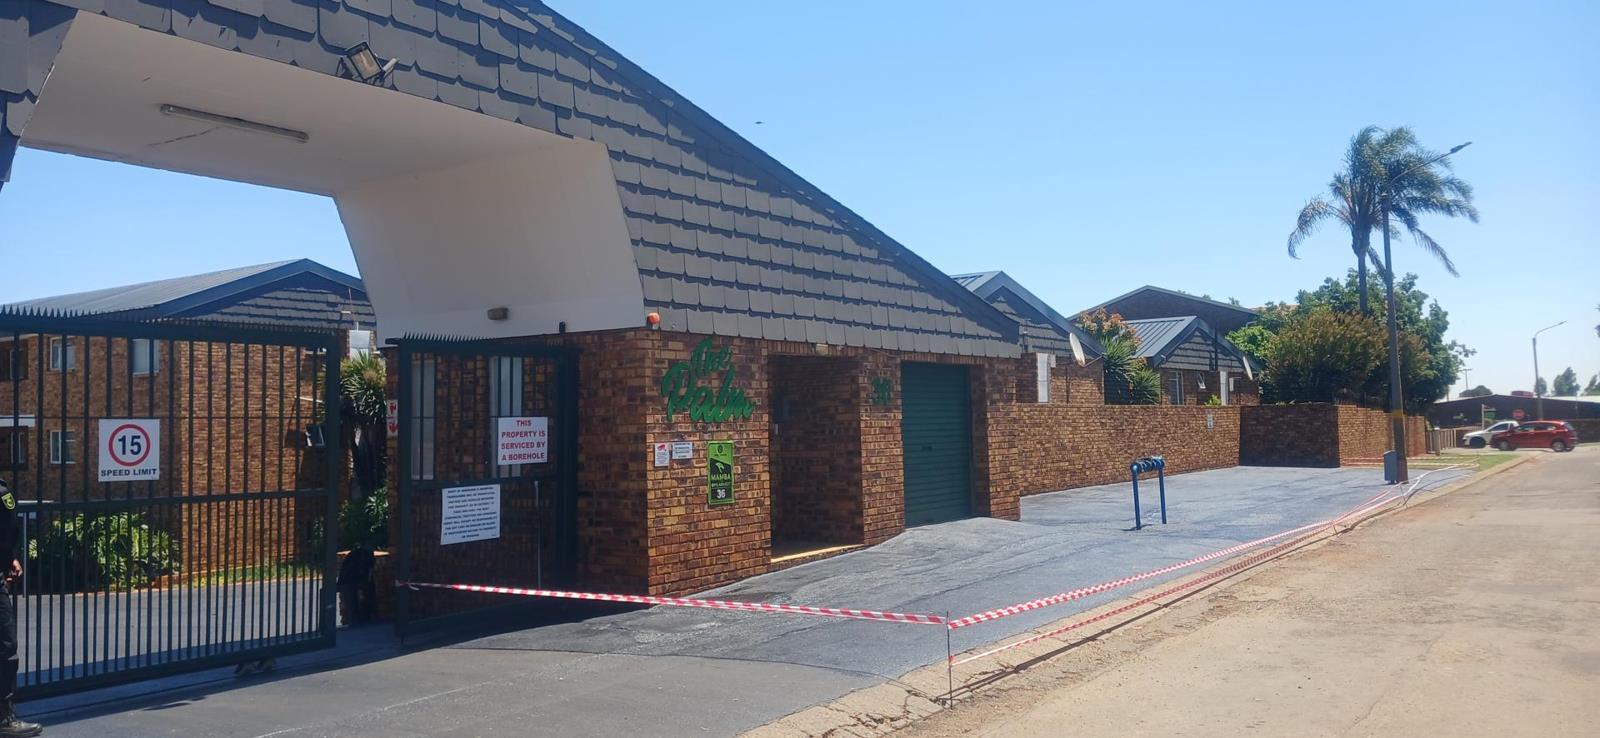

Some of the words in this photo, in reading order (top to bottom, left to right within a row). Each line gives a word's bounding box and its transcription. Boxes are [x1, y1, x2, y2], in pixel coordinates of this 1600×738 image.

[661, 362, 754, 422] Palm
[118, 435, 142, 455] 15
[101, 469, 130, 477] SPEED
[716, 489, 726, 499] 36
